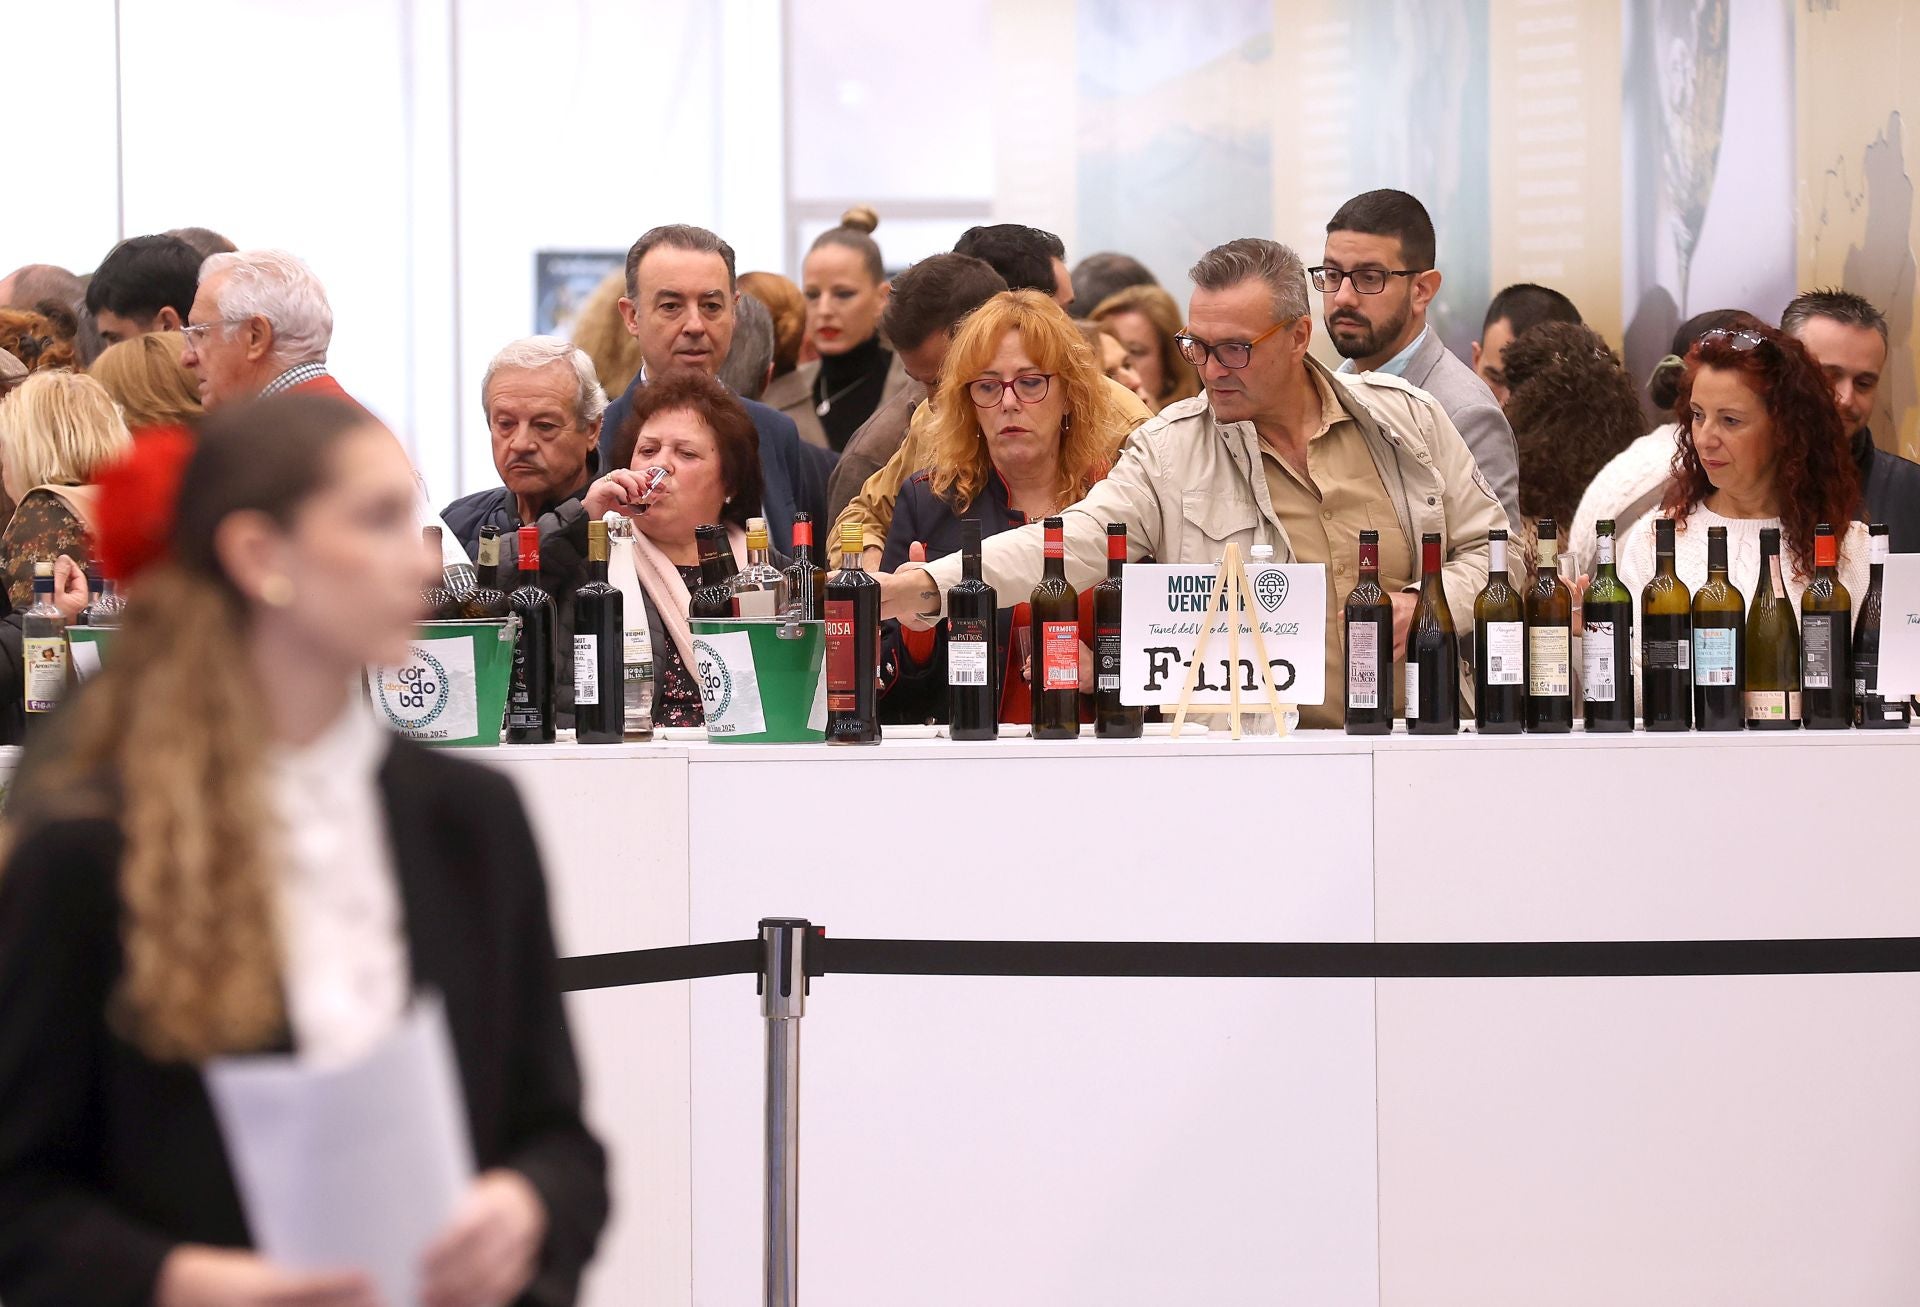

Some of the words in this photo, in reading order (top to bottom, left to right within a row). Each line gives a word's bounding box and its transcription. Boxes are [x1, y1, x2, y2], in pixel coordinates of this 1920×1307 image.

[825, 622, 851, 636] ROSA
[1149, 622, 1176, 635] Túnel
[1177, 622, 1195, 635] del
[1217, 622, 1229, 634] de
[1274, 622, 1299, 636] 2025
[957, 633, 983, 641] PATIOS
[410, 680, 436, 695] do
[400, 692, 425, 708] ba
[411, 730, 429, 738] Vino
[430, 729, 449, 739] 2025
[721, 724, 736, 732] 2025
